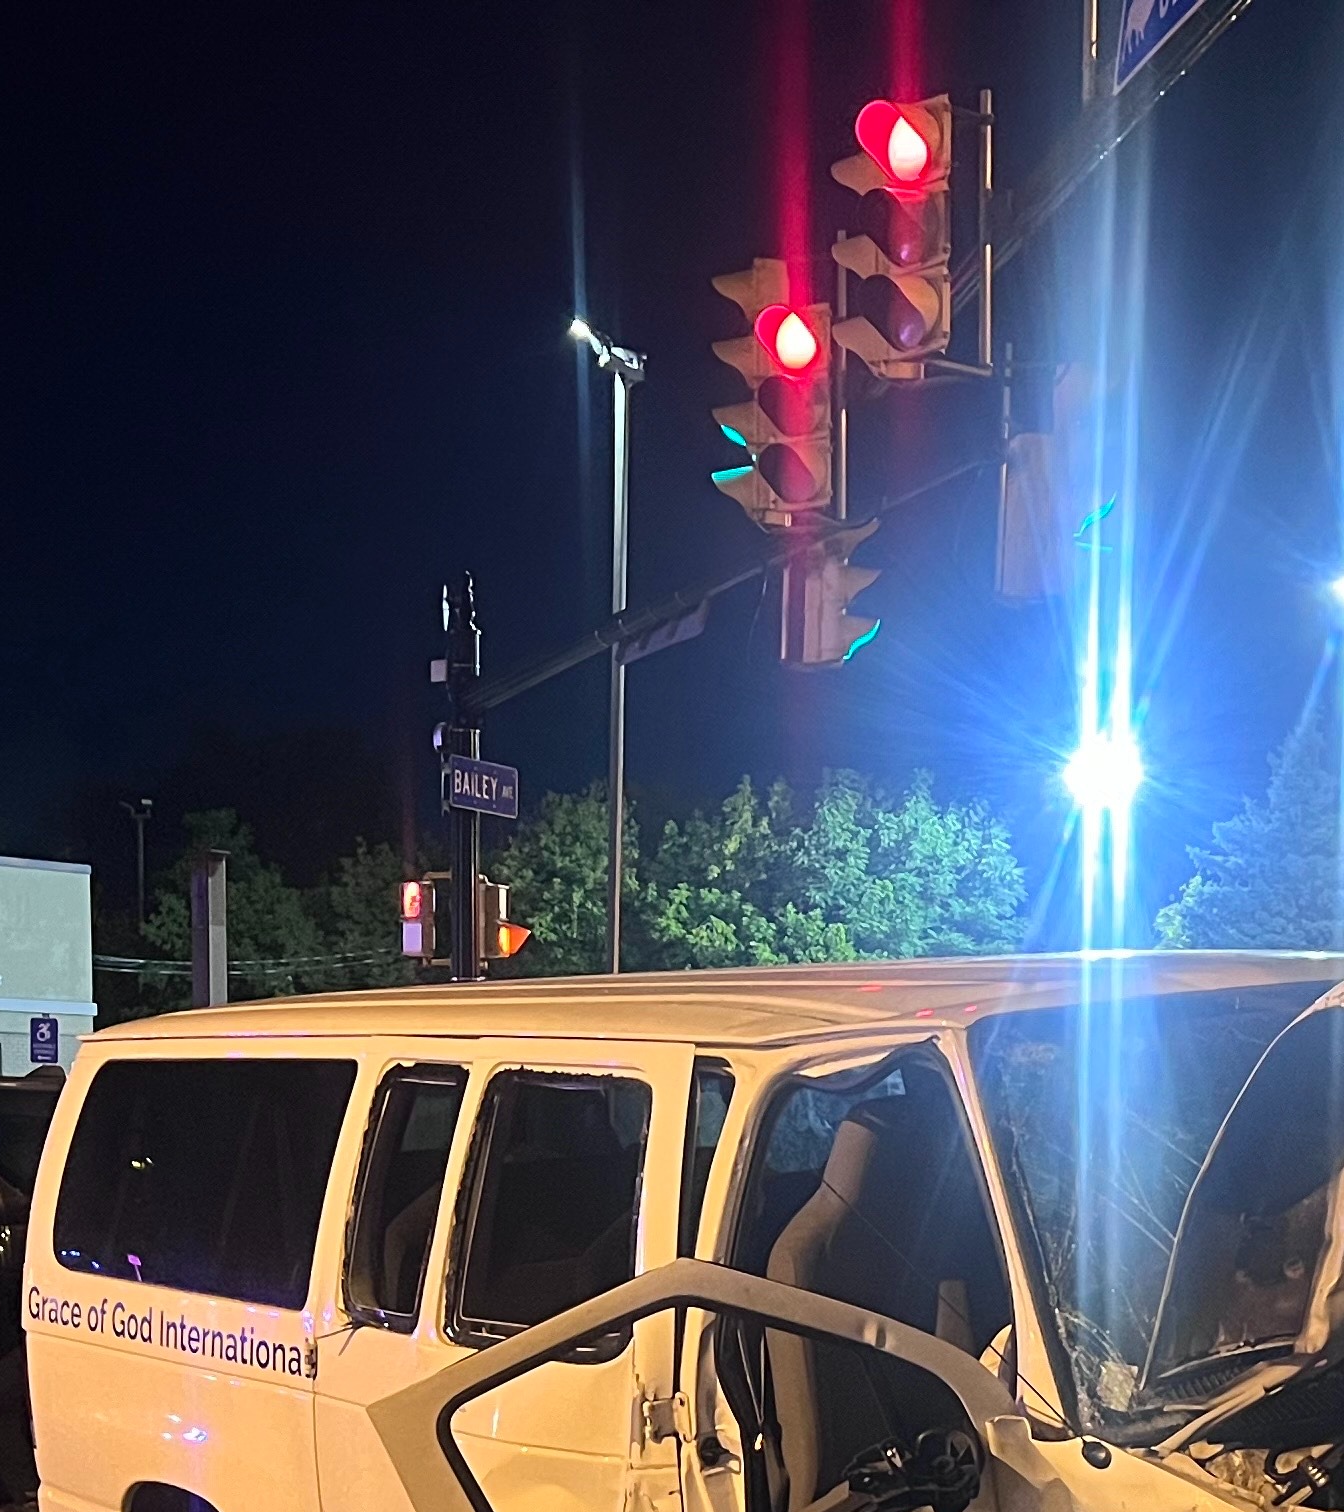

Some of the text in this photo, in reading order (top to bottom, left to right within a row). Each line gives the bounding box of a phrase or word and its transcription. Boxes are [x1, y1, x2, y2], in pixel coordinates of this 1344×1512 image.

[454, 769, 498, 801] BAILEY
[28, 1286, 310, 1378] Grace of God Internationa
